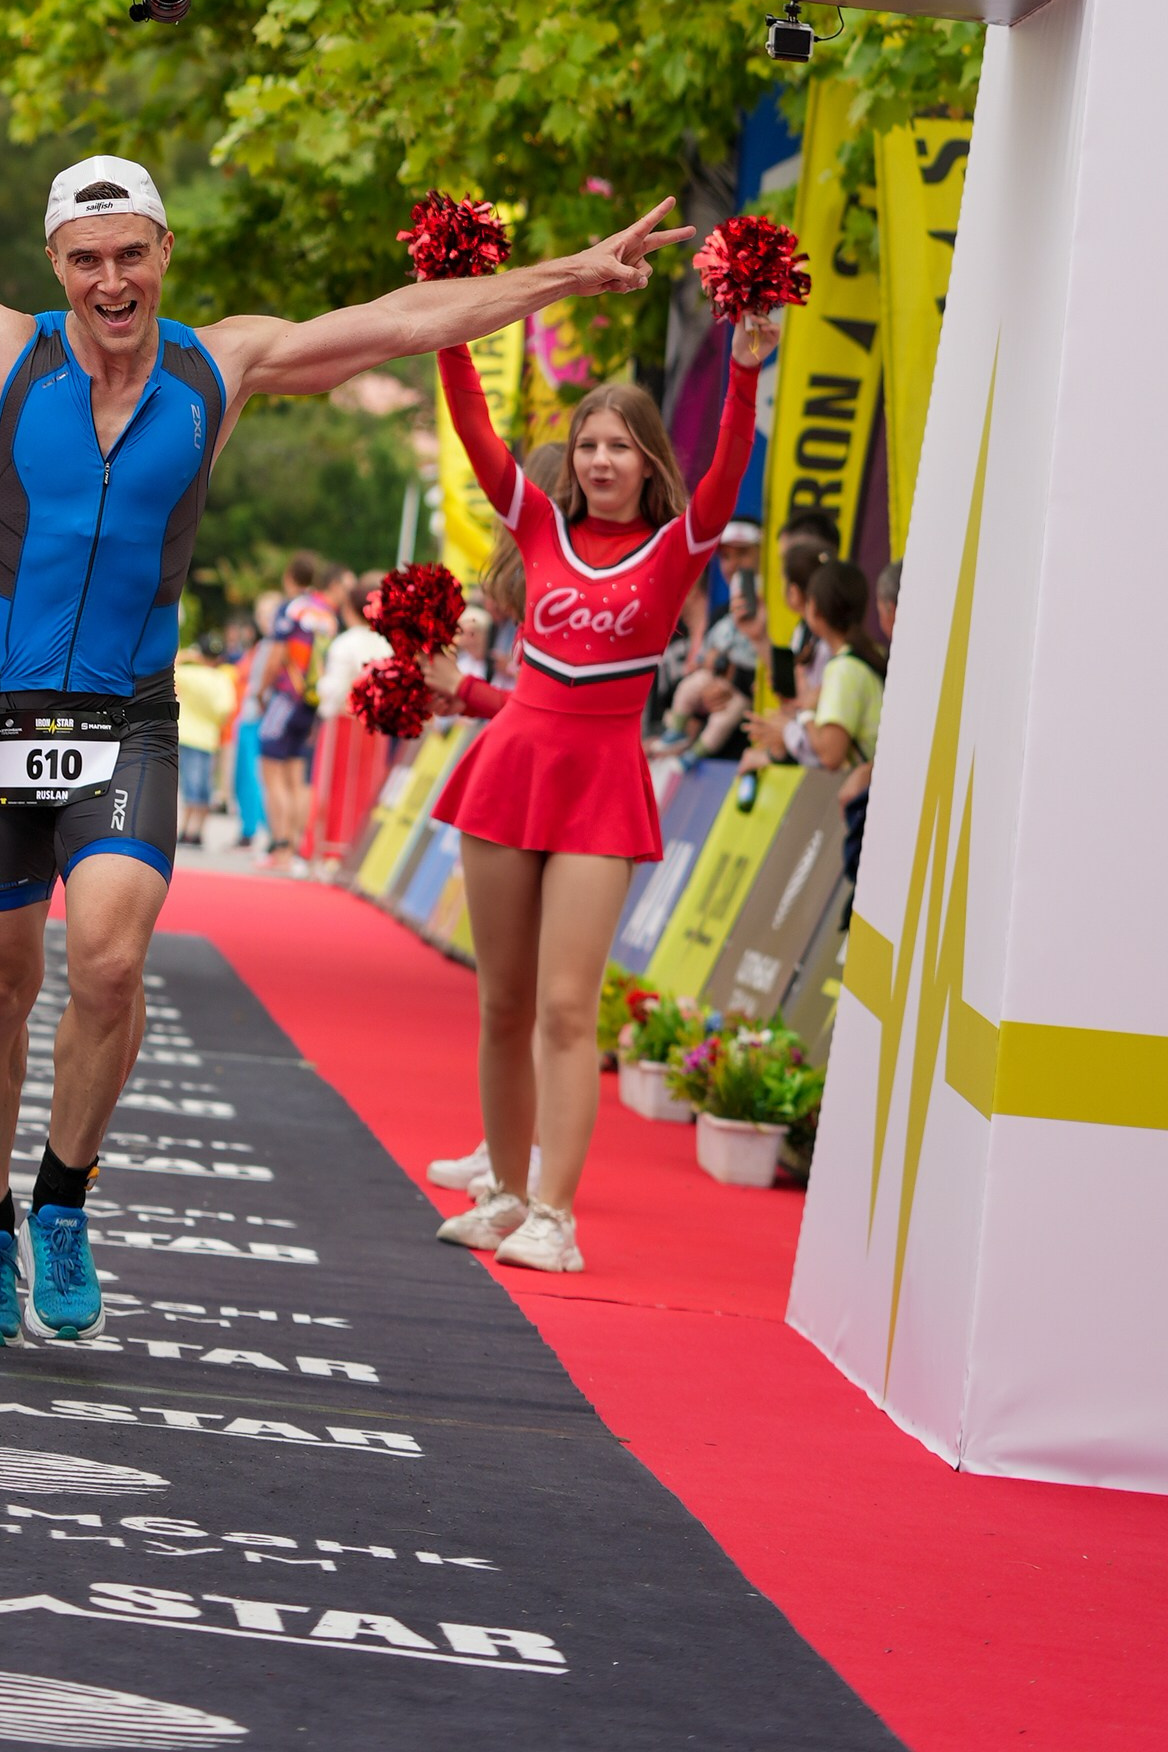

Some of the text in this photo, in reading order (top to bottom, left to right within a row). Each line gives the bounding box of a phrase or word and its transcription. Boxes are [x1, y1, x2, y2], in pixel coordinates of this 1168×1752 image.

[85, 201, 114, 212] sailfish
[190, 403, 202, 450] 2XU
[788, 373, 863, 520] RON
[533, 586, 641, 637] Cool
[35, 718, 75, 728] IRON STAR
[26, 748, 83, 781] 610
[35, 790, 69, 801] RUSLAN
[110, 788, 129, 831] 2XU
[54, 1217, 79, 1228] HOKA
[87, 1229, 320, 1264] TAR
[50, 1399, 424, 1452] STAR
[89, 1581, 568, 1664] STAR
